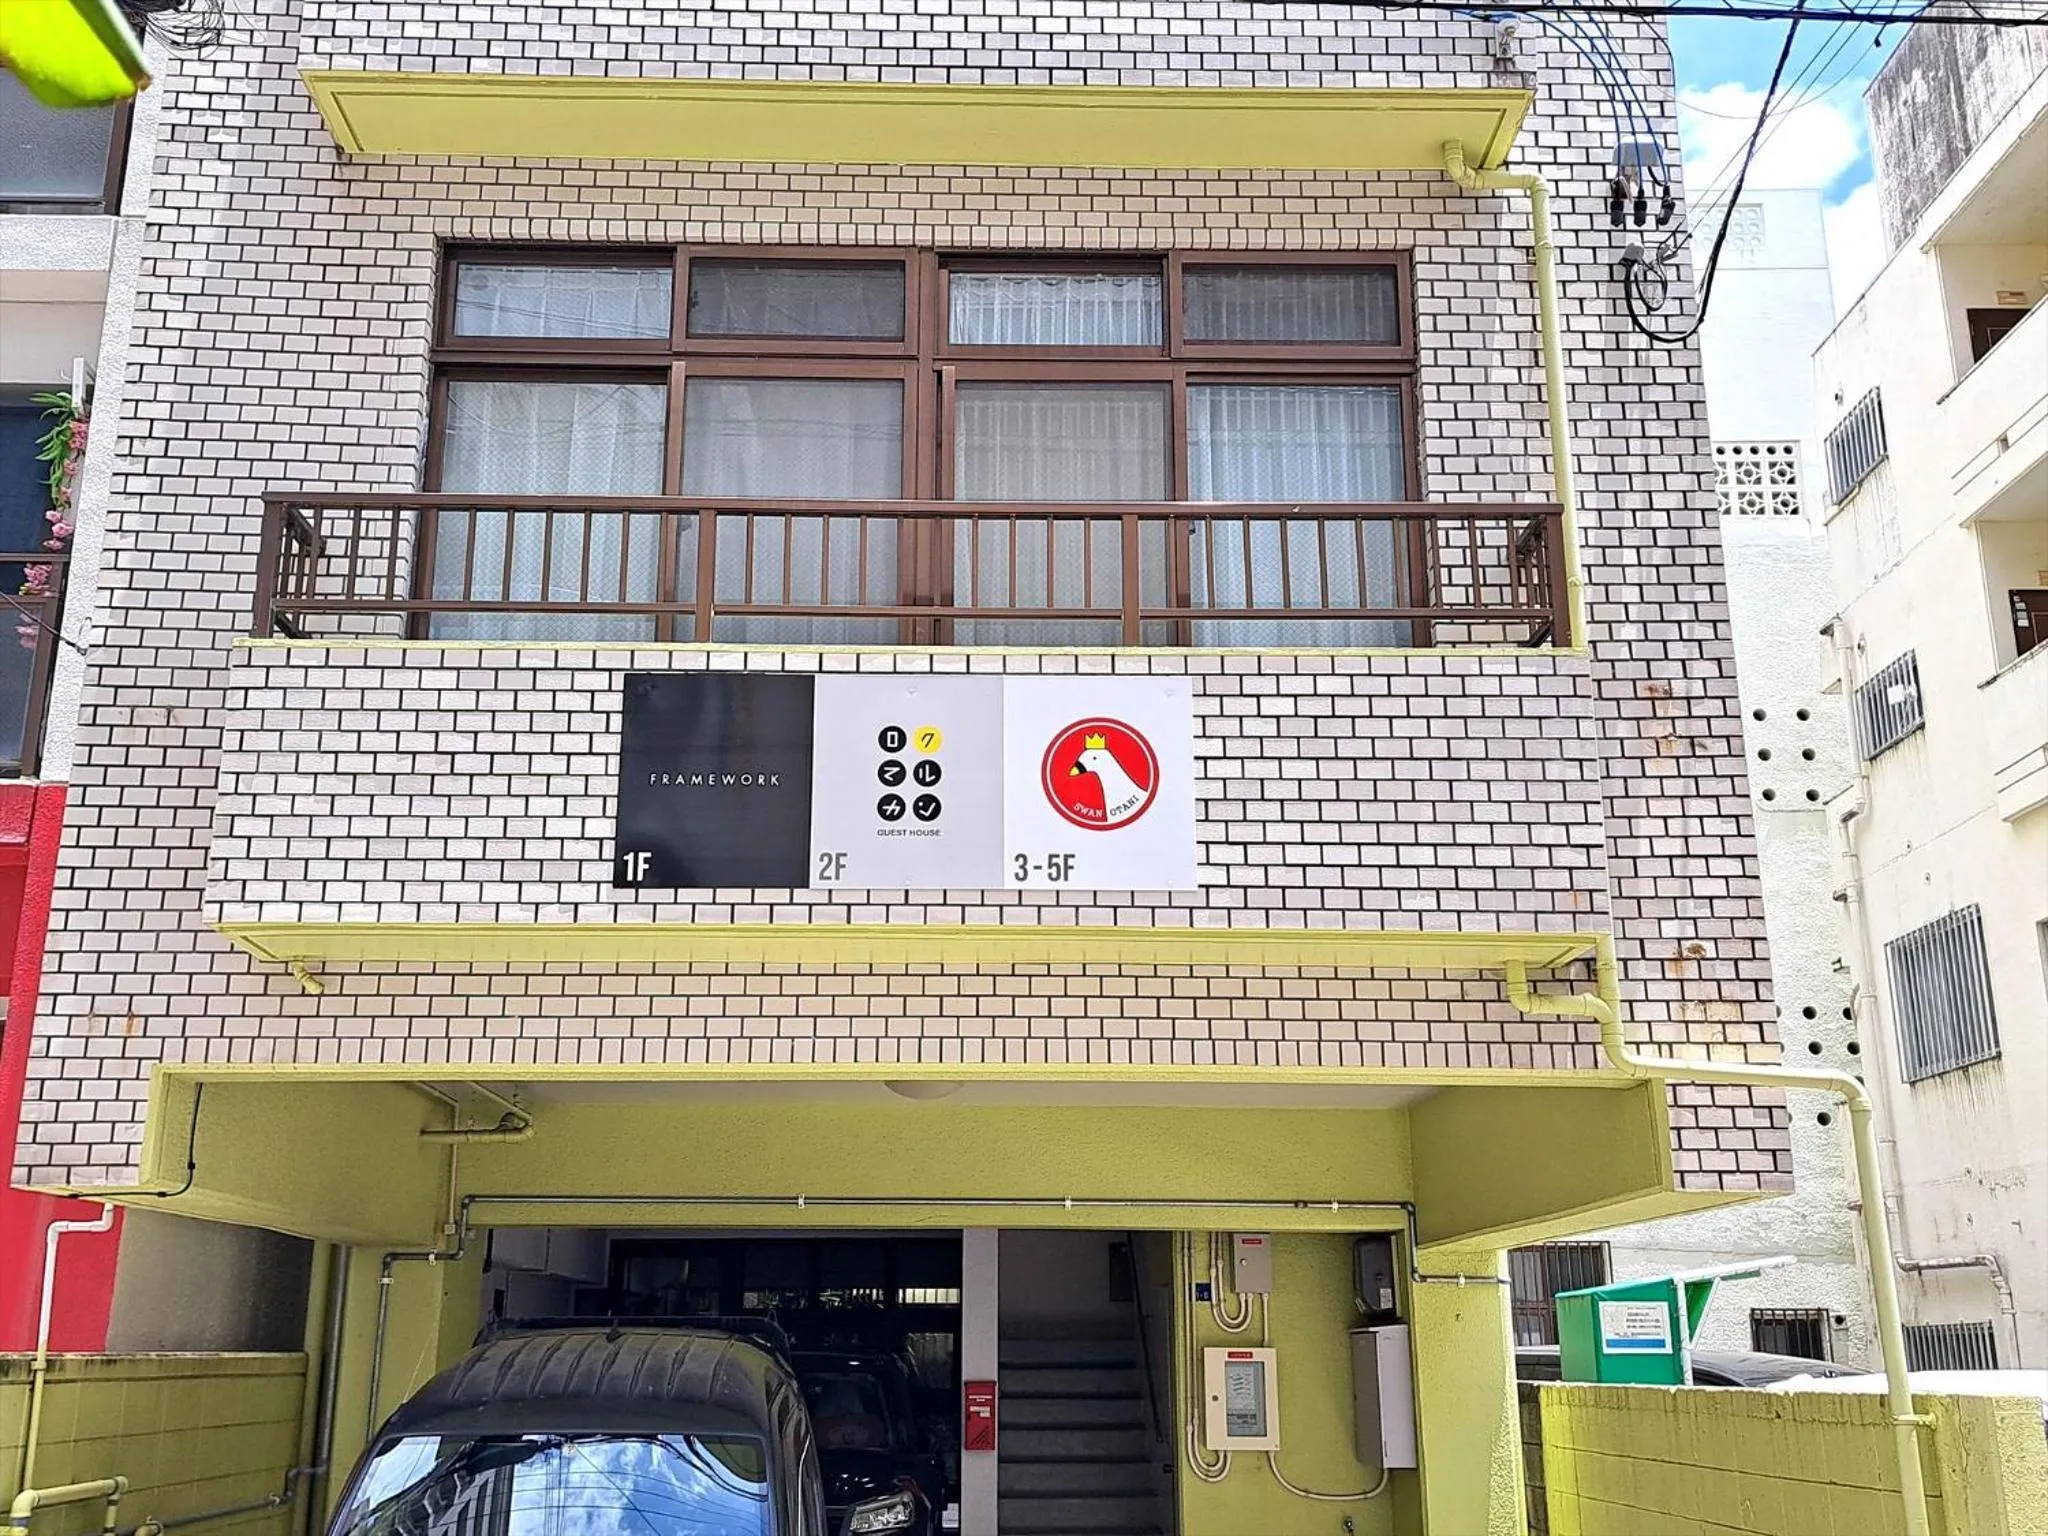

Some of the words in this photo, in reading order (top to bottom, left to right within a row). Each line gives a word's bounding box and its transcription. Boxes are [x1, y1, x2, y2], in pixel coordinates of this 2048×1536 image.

[649, 773, 781, 786] FRAMEWORK
[1073, 802, 1103, 818] SWAN
[1109, 794, 1140, 817] OTANI
[877, 828, 907, 837] GUEST
[909, 828, 941, 837] HOUSE
[623, 851, 652, 882] 1F
[818, 852, 848, 881] 2F
